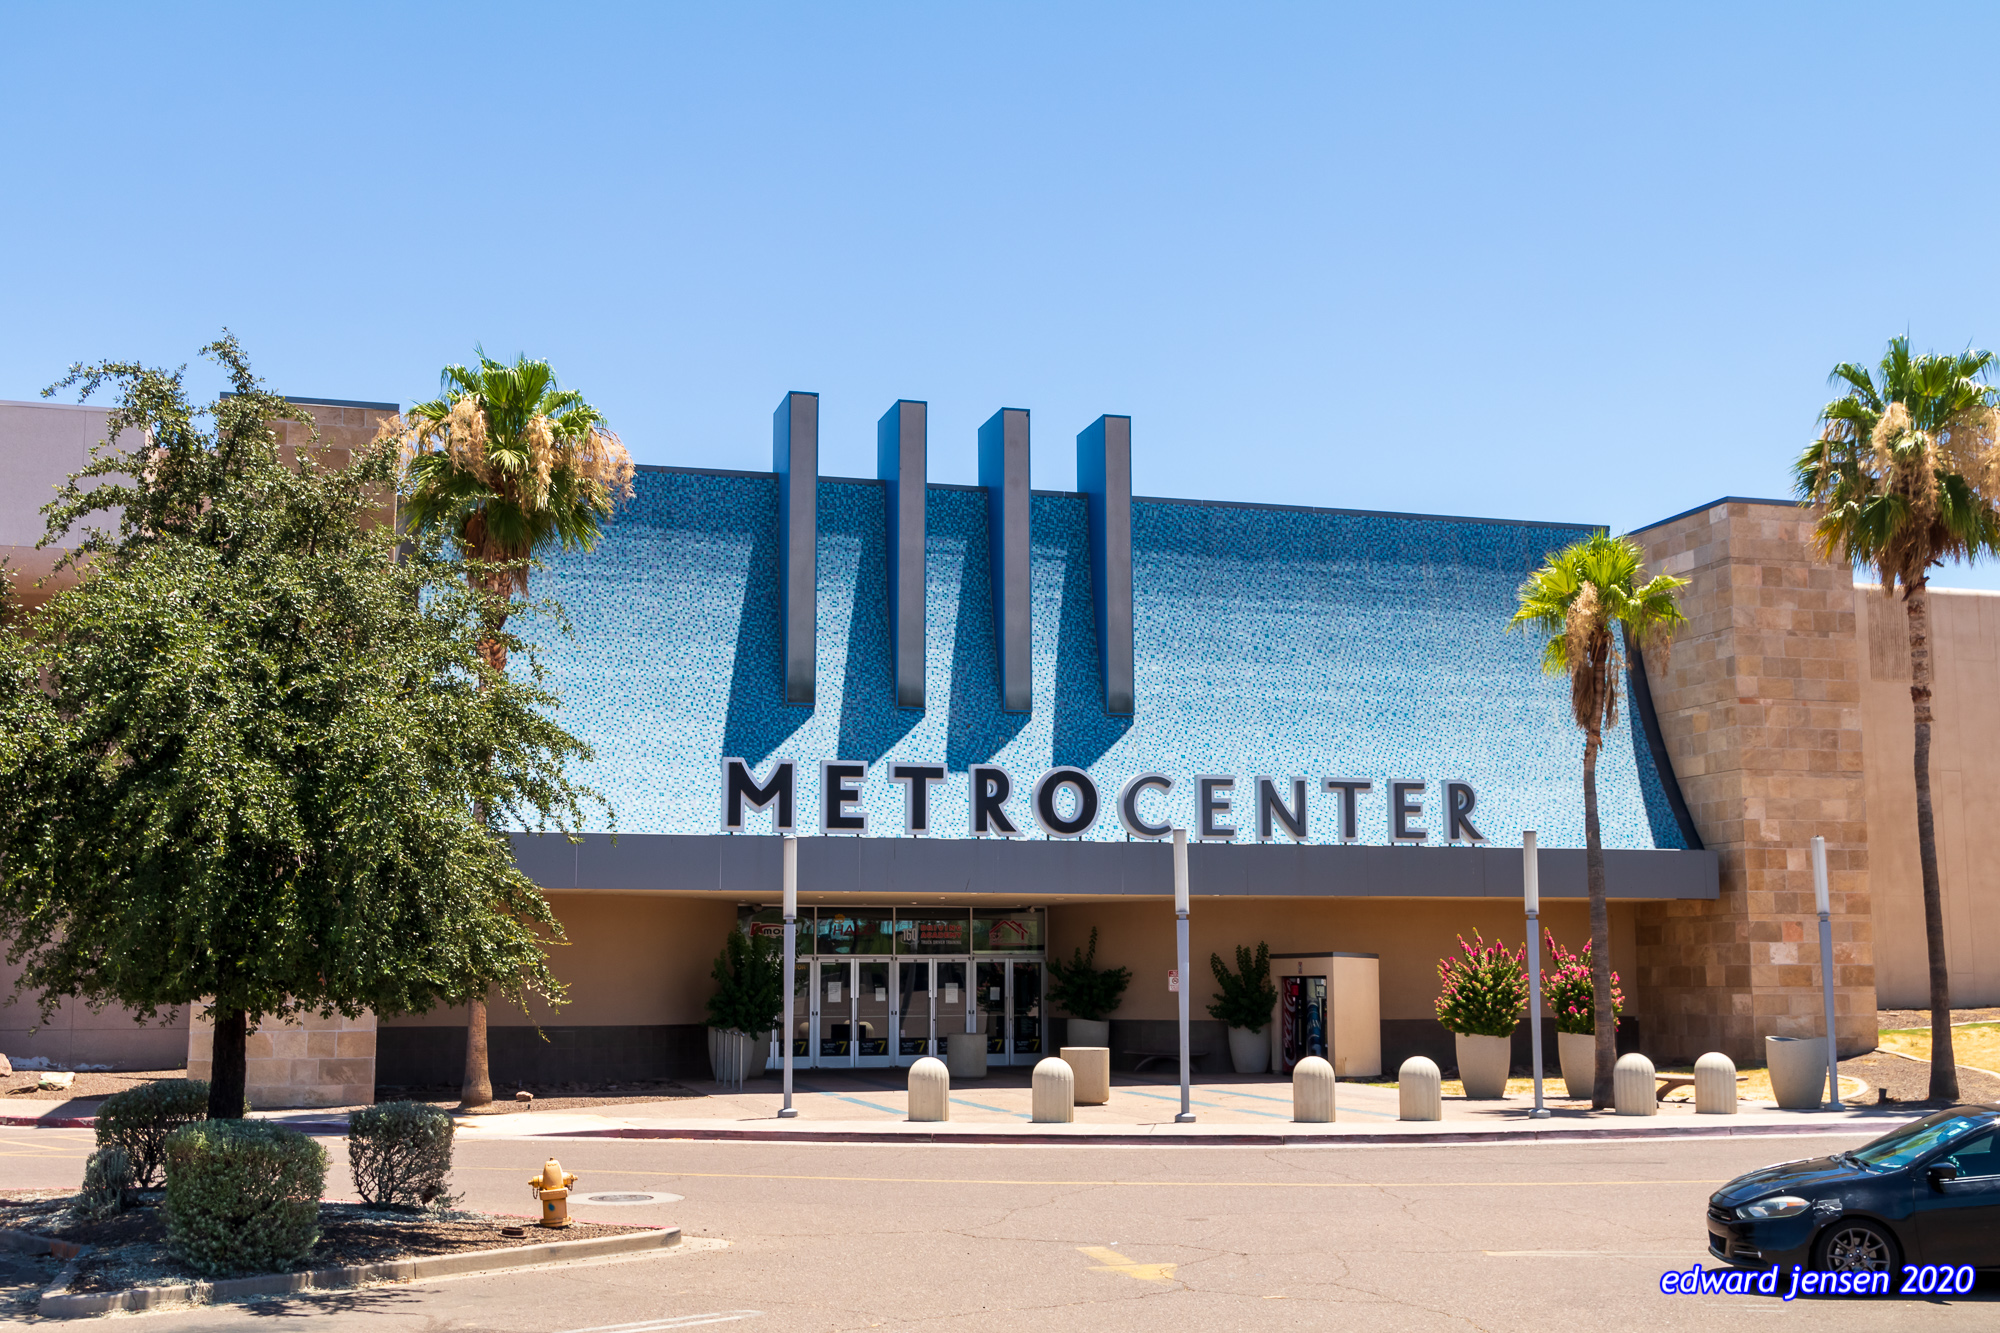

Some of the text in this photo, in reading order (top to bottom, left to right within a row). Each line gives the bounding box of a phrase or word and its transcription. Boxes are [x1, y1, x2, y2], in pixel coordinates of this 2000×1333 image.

[721, 757, 1486, 843] METROCENTER
[920, 924, 963, 932] DRIVING
[920, 931, 963, 939] ACADEMY
